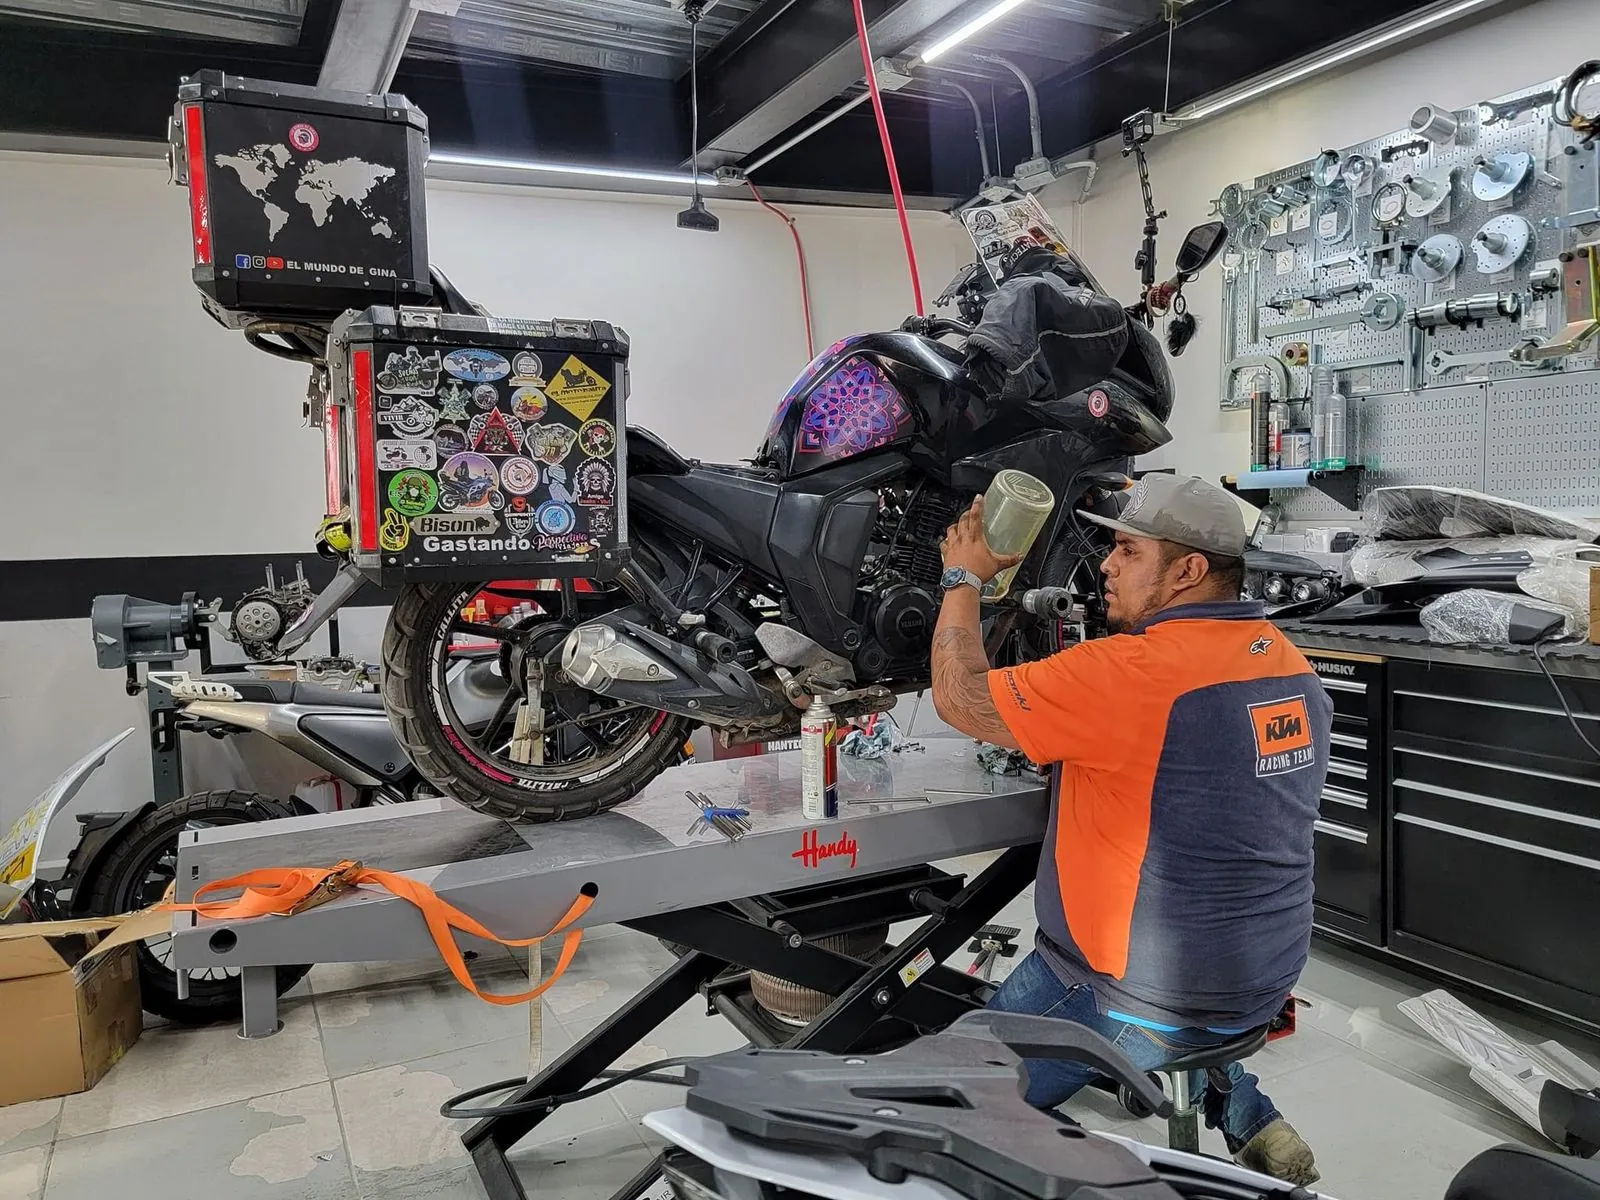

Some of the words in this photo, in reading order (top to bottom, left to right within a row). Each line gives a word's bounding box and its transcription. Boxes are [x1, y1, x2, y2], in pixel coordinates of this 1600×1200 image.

[286, 260, 301, 270] EL
[304, 262, 347, 274] MUNDO
[350, 265, 364, 275] DE
[369, 267, 397, 279] GINA
[420, 517, 476, 533] Bison
[423, 536, 531, 552] Gastando
[437, 591, 469, 640] CALLITA
[1317, 661, 1355, 676] HUSKY
[1265, 713, 1302, 742] KTM
[1259, 753, 1291, 772] RACING
[1294, 747, 1314, 763] TEAM
[791, 829, 857, 869] Handy
